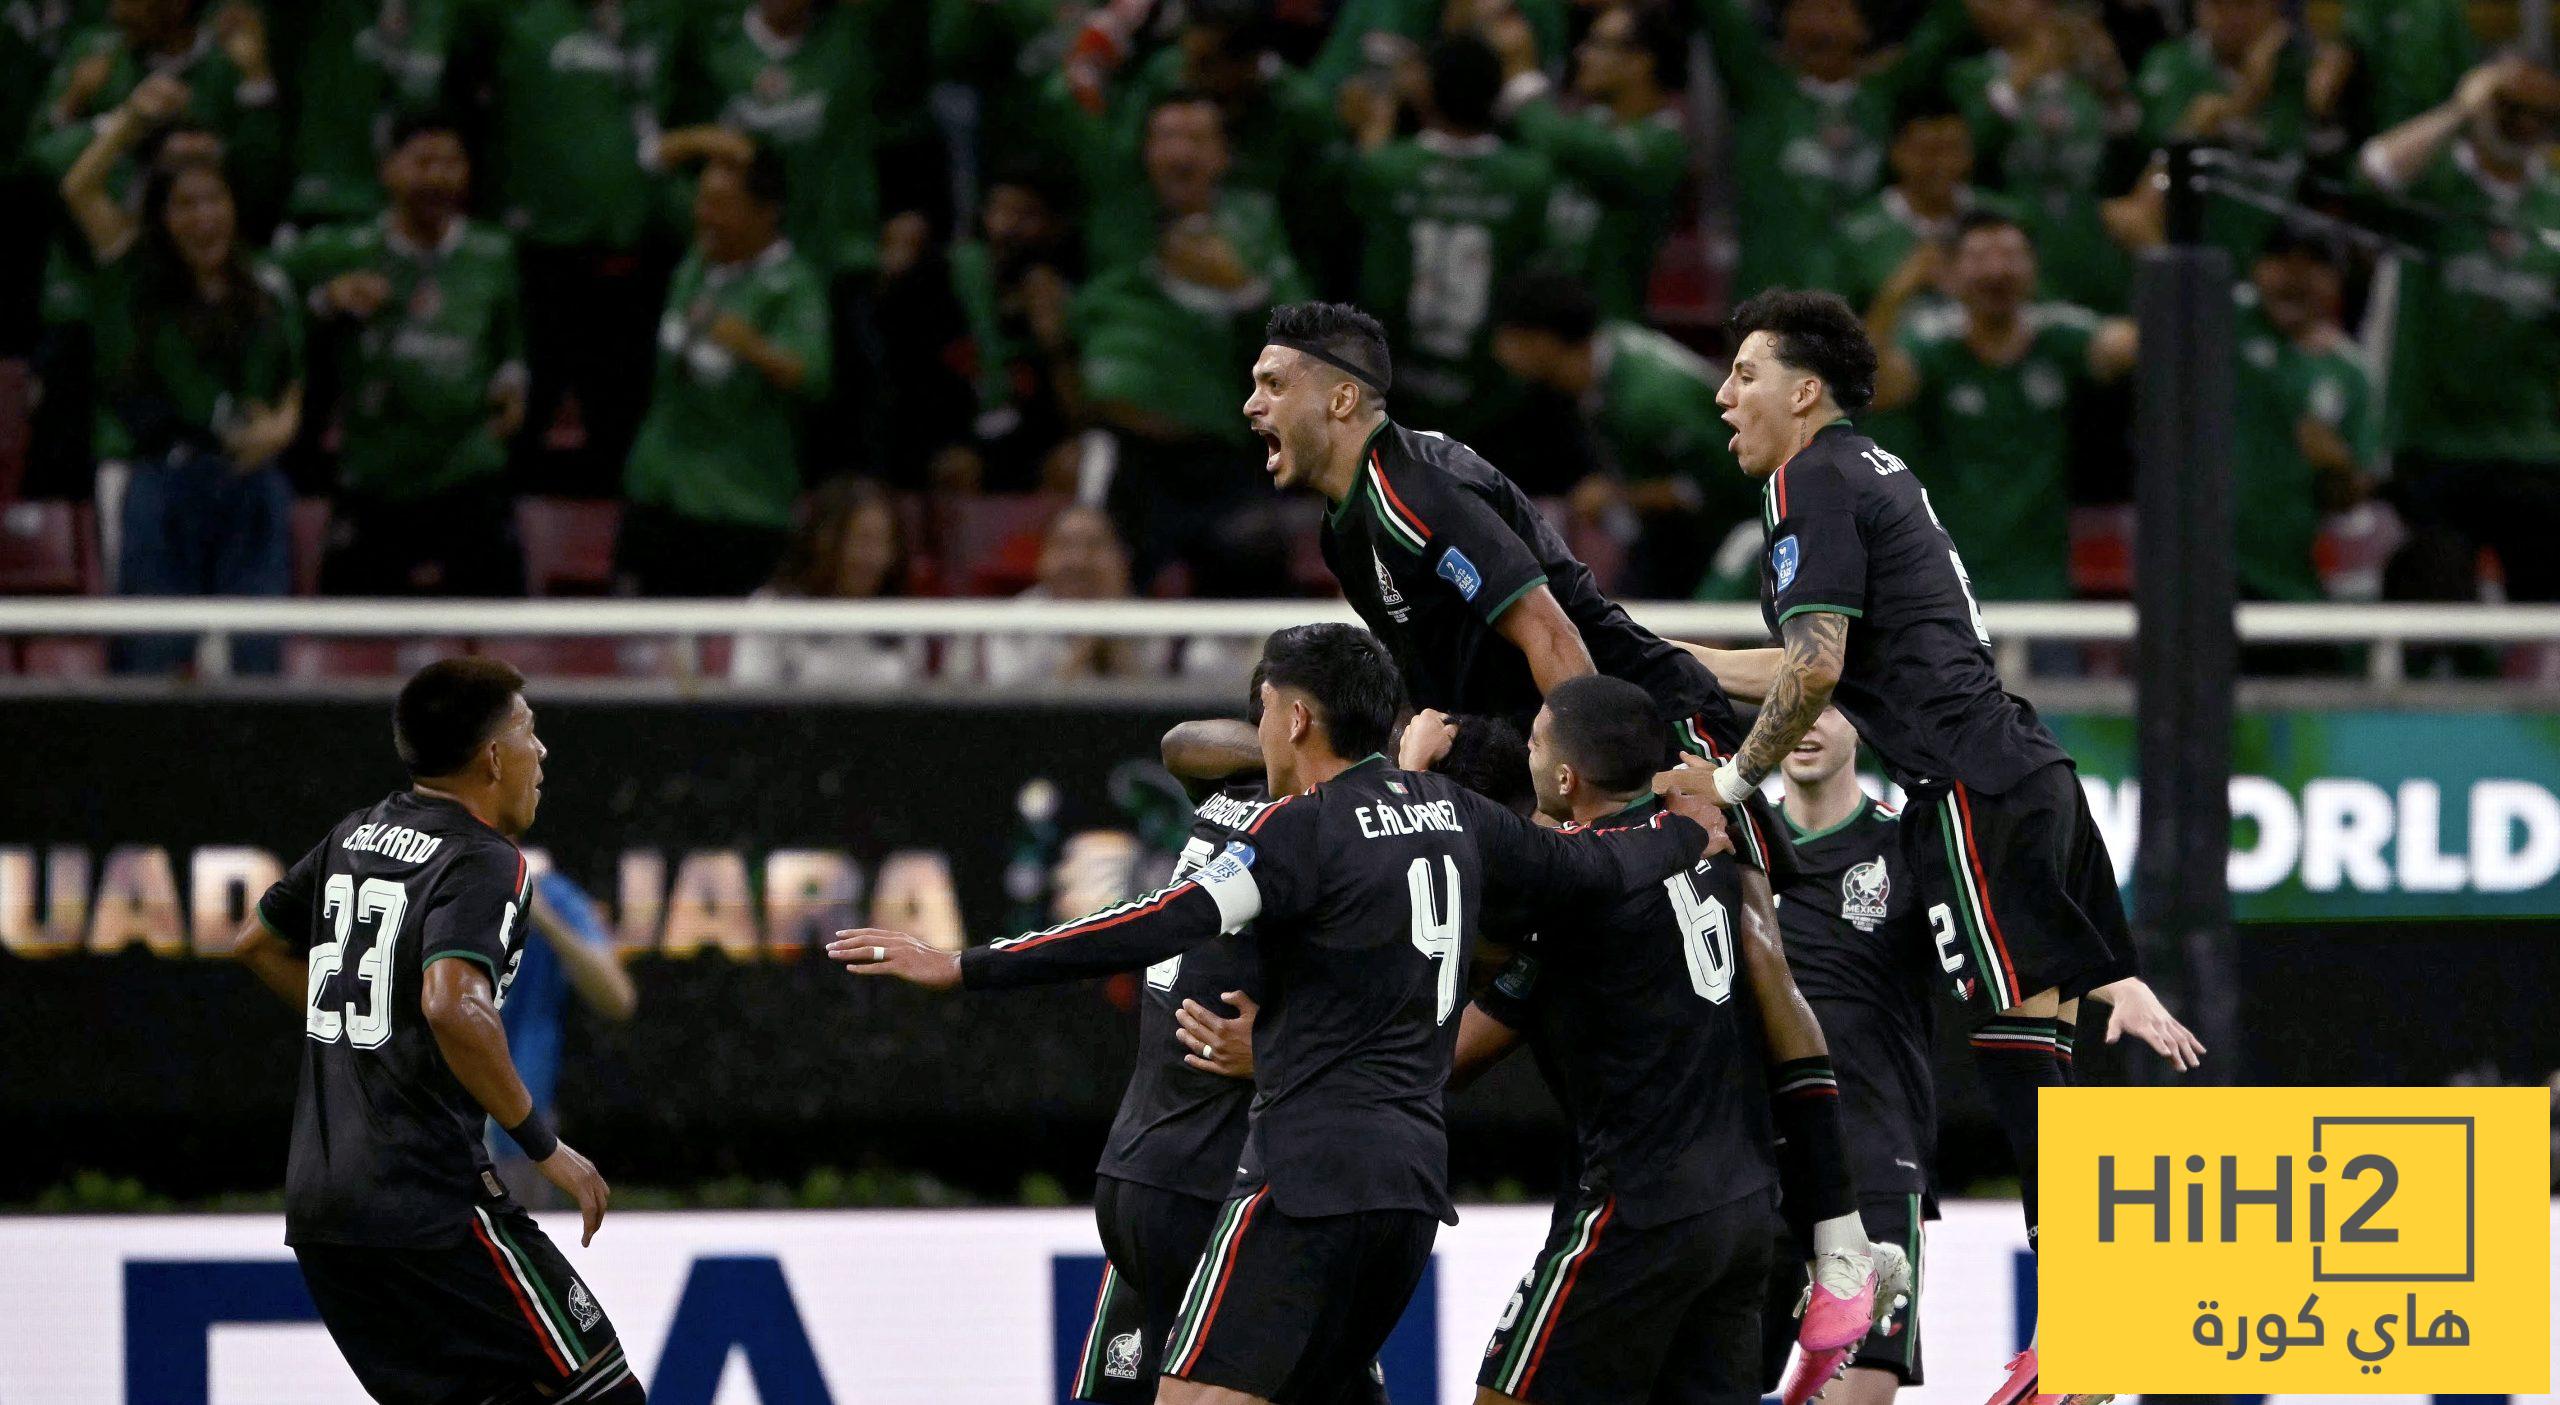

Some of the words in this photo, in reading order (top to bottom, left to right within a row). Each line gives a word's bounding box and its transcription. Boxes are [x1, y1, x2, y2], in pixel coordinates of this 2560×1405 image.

[342, 820, 443, 864] J.GALLARDO
[1355, 799, 1463, 838] E.ÁLVAREZ
[306, 873, 409, 1049] 23
[1407, 855, 1461, 1026] 4
[1663, 859, 1735, 1005] 6
[1929, 903, 1965, 973] 2
